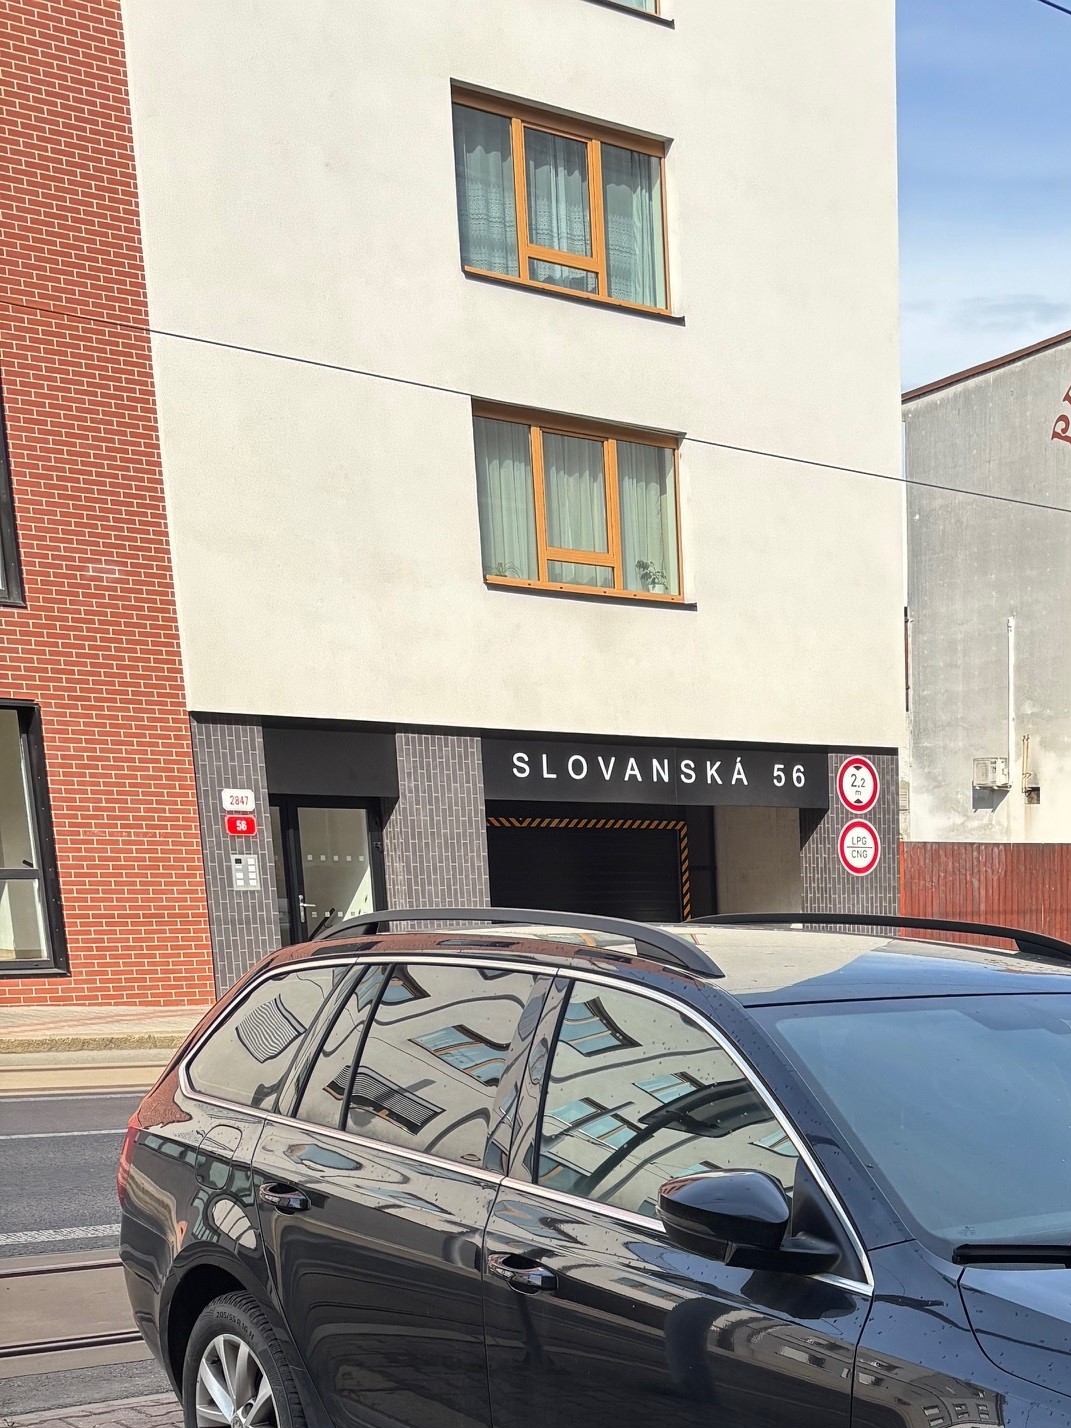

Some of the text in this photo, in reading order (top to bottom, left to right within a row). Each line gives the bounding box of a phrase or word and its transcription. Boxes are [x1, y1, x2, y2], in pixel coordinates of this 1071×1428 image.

[512, 753, 806, 787] SLOVANSKÁ 56
[229, 795, 249, 805] 2847
[236, 820, 247, 831] 56
[851, 836, 867, 845] LPG
[851, 850, 868, 859] CNG
[216, 1311, 236, 1322] 205/55
[236, 1318, 241, 1326] R
[241, 1322, 248, 1333] 16
